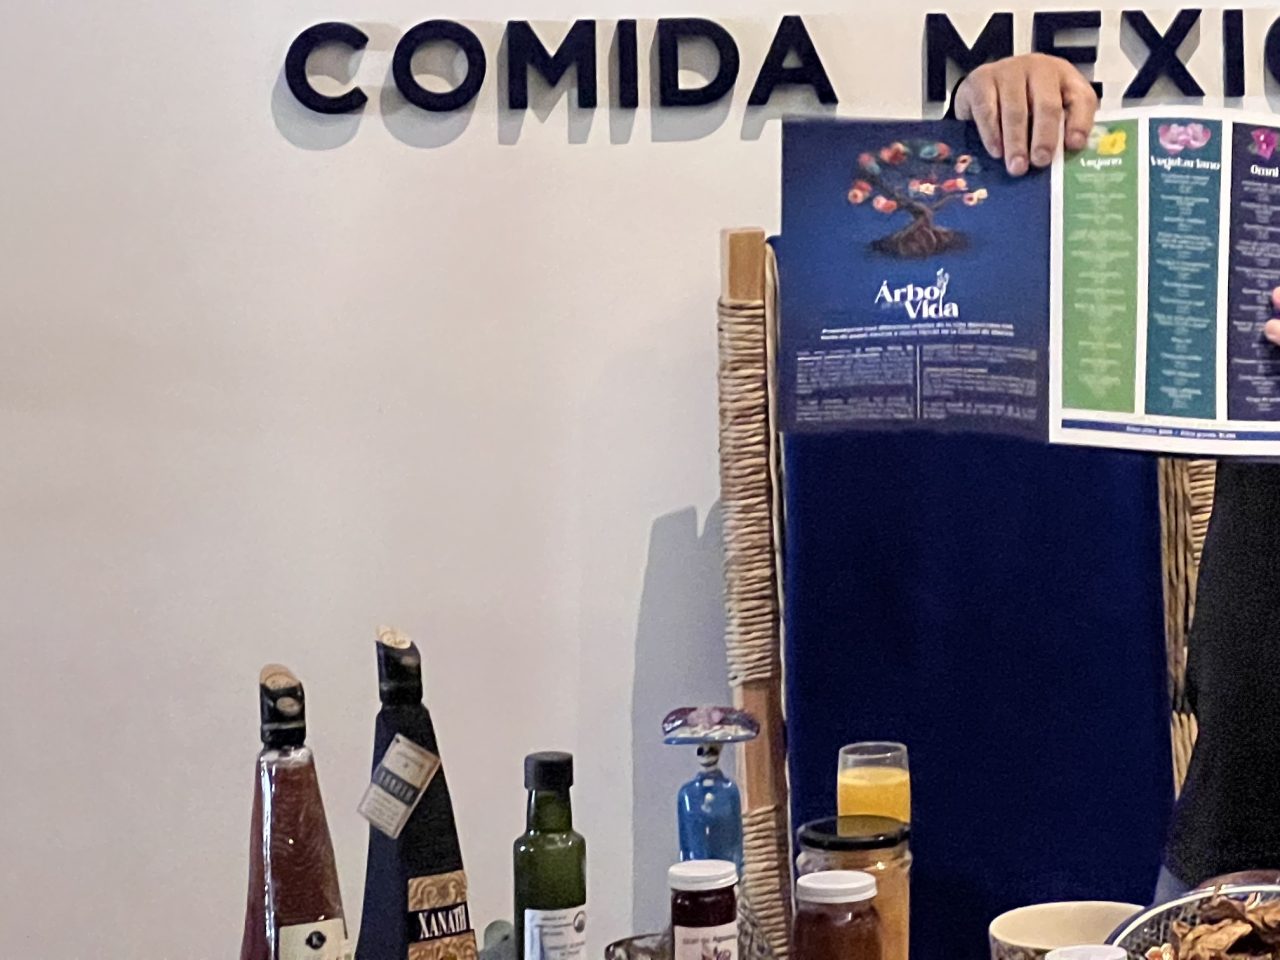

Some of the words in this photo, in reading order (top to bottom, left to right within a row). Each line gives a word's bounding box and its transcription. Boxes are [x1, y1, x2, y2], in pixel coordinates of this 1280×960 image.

[284, 14, 839, 115] COMIDA
[904, 298, 959, 320] Vida
[418, 904, 467, 940] XANATH
